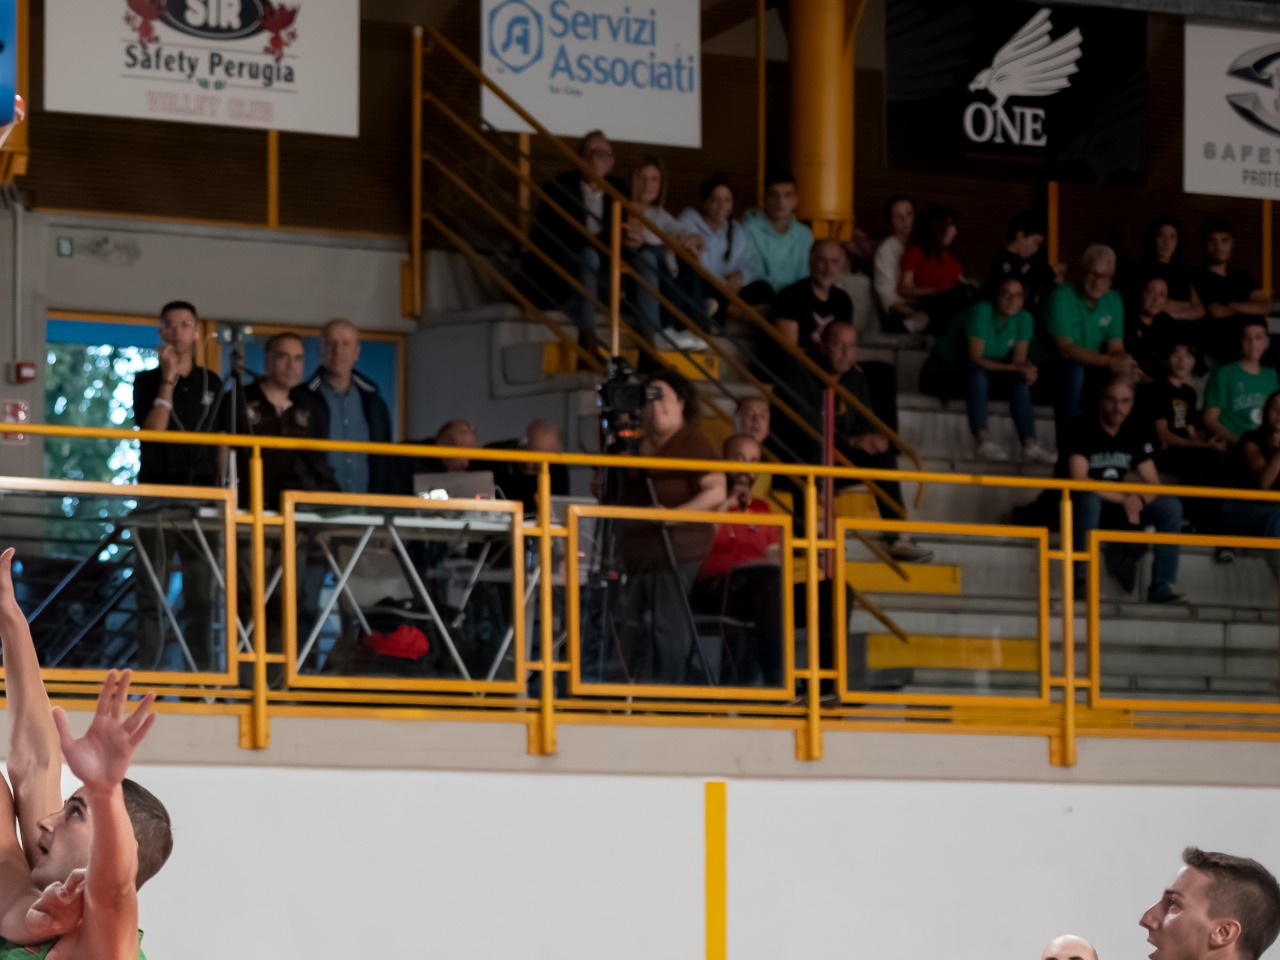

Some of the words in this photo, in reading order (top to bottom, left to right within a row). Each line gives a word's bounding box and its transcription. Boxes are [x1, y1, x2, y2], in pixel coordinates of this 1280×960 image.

[185, 0, 241, 29] SIR
[549, 0, 657, 46] Servizi
[124, 44, 199, 79] Safety
[209, 52, 295, 86] Perugia
[549, 44, 695, 92] Associati
[963, 102, 1047, 147] ONE
